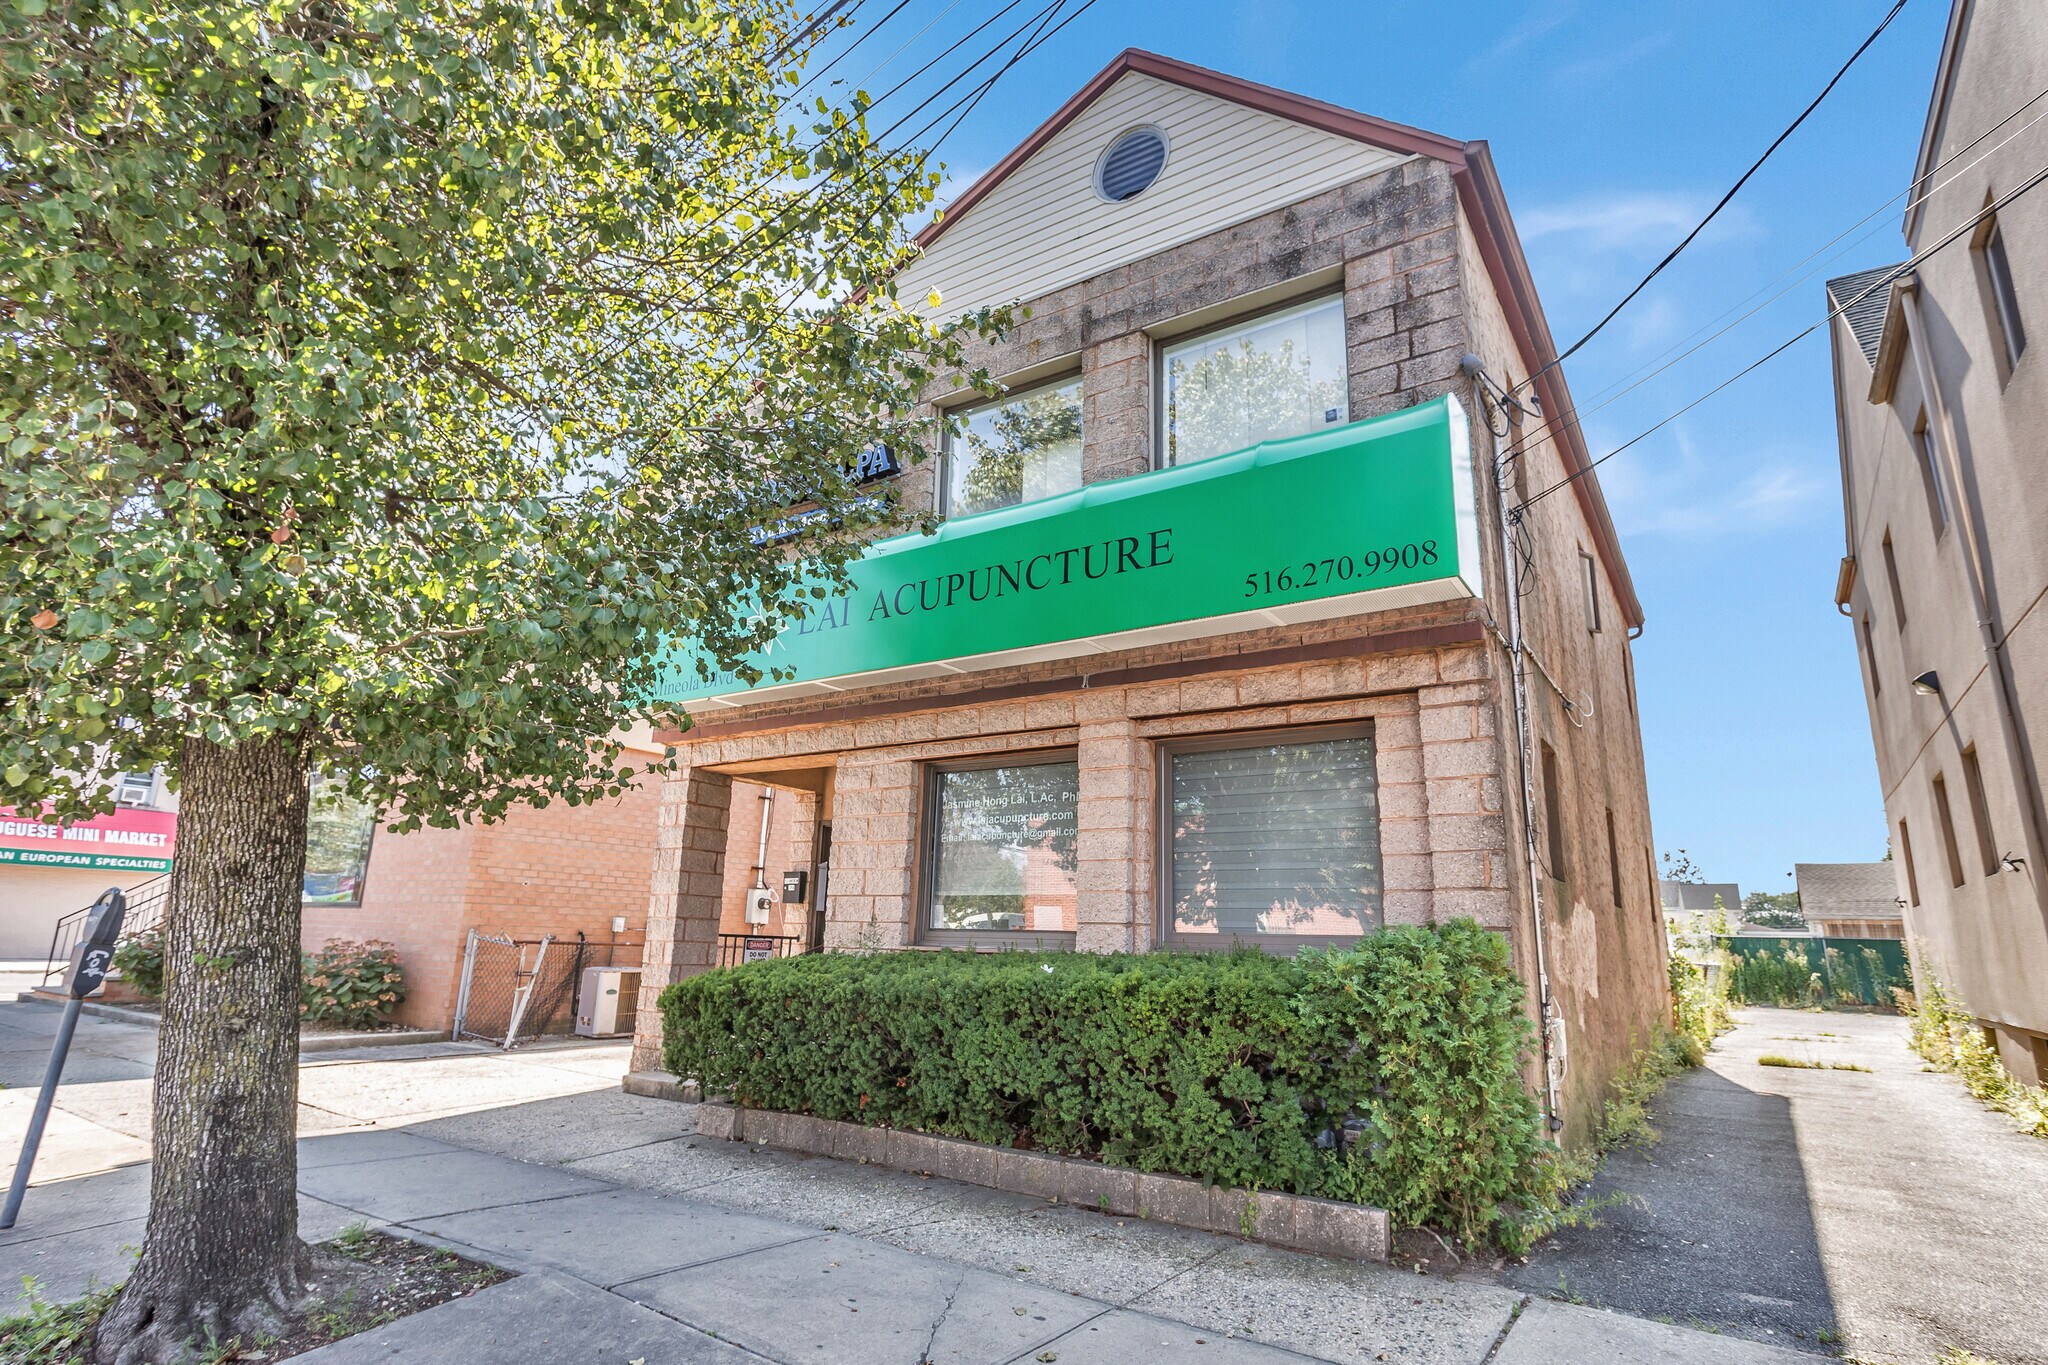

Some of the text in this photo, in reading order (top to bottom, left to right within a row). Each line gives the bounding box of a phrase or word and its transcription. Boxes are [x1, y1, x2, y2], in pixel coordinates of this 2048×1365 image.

[1244, 539, 1439, 597] 516.270.9908
[798, 528, 1175, 636] LAI ACUPUNCTURE
[942, 797, 980, 810] Jasmine
[982, 795, 1008, 807] Hong
[1011, 794, 1028, 805] Lai,
[954, 811, 1074, 827] www.laiacupuncture.com
[62, 827, 100, 842] MINI
[104, 830, 167, 847] MARKET
[20, 852, 91, 865] EUROPEAN
[95, 857, 166, 869] SPECIALTIES
